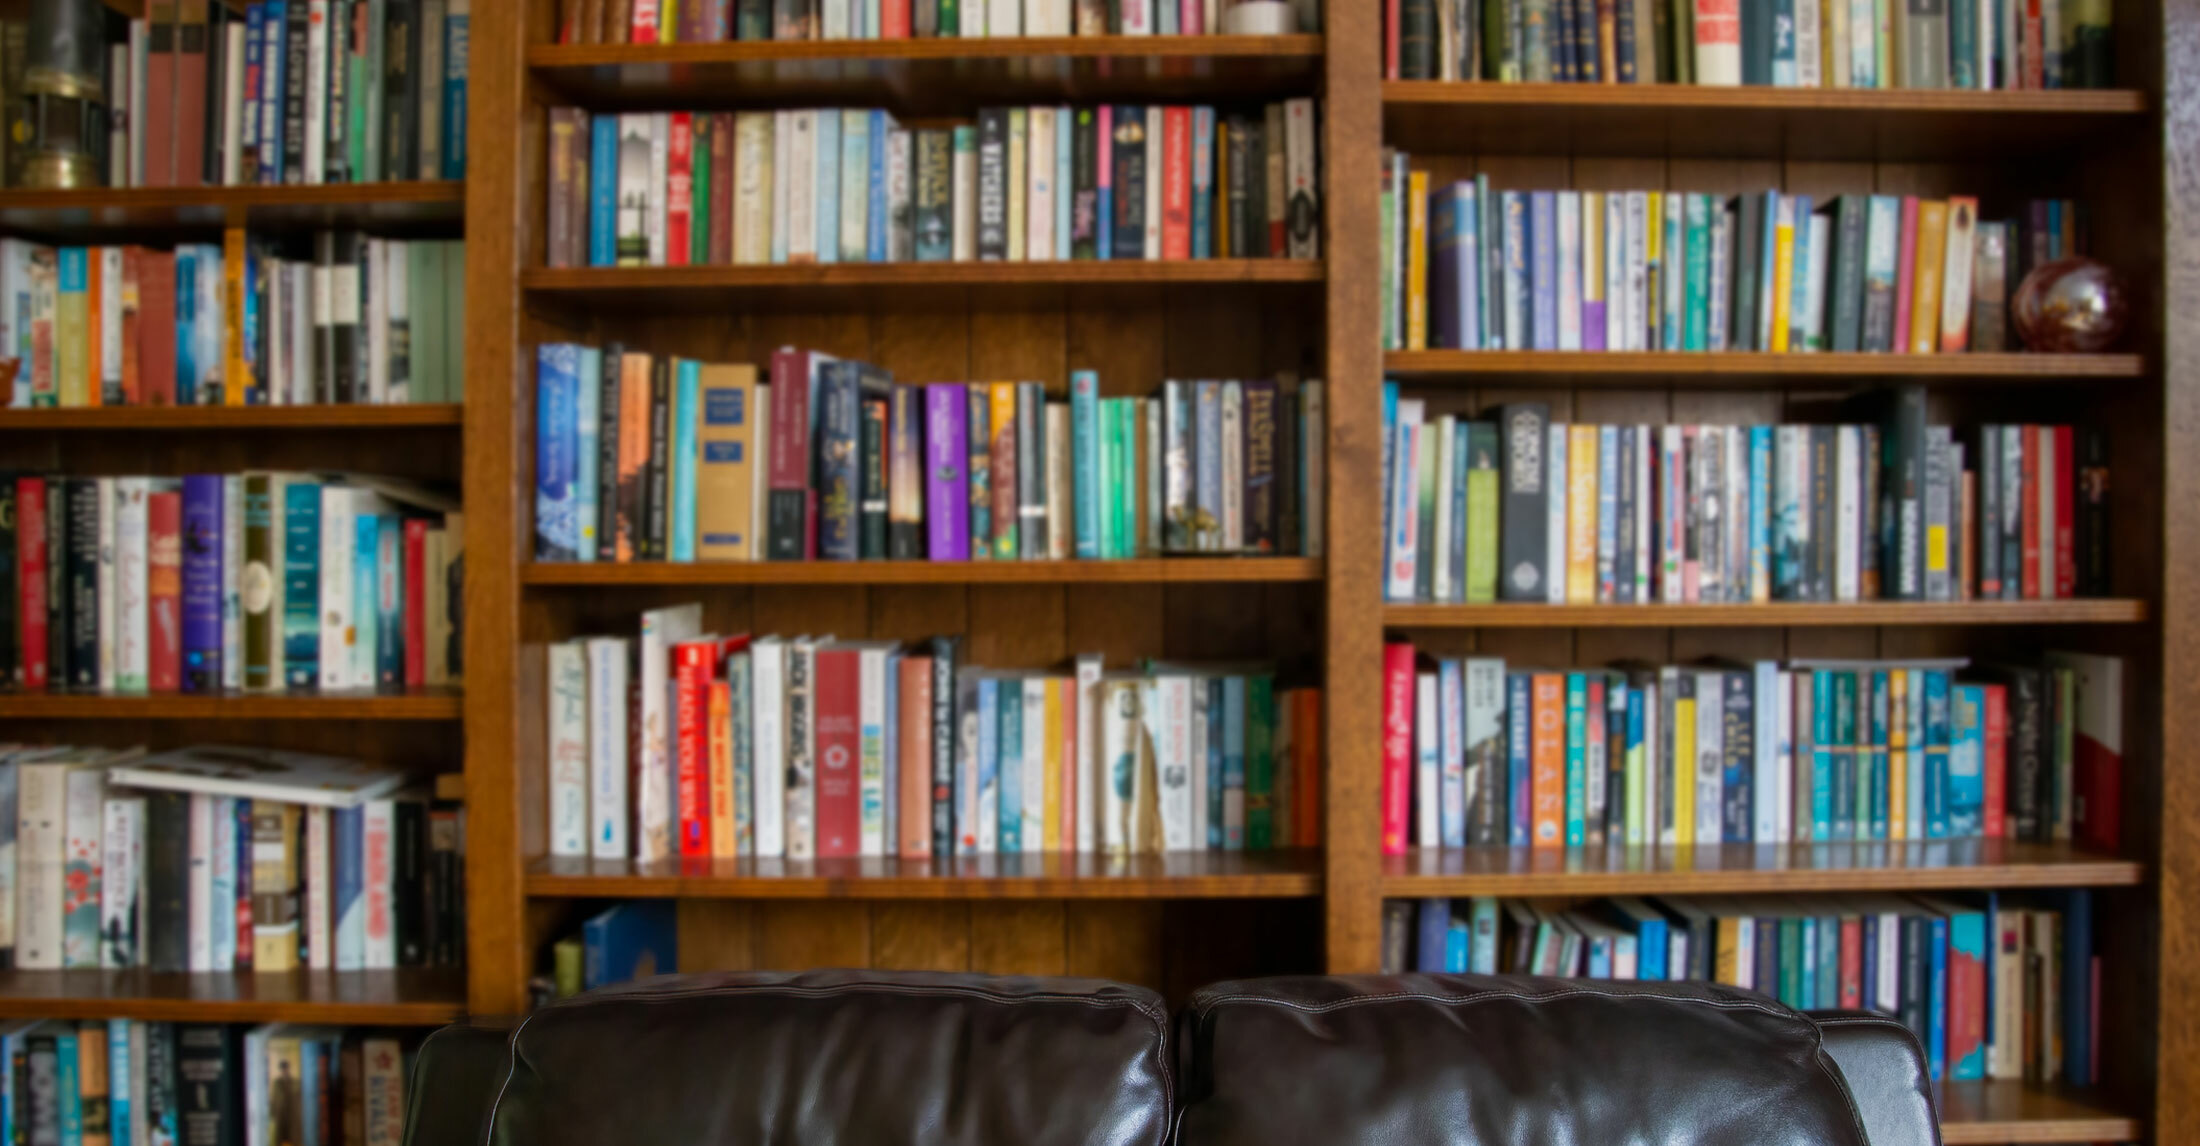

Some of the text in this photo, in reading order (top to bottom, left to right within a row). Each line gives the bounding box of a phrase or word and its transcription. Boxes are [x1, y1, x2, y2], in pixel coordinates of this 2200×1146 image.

[934, 658, 950, 703] JOHN
[678, 665, 699, 820] HEADS YOU WIN
[790, 694, 807, 759] HIGGINS
[1723, 712, 1737, 767] CHILD
[1737, 722, 1751, 757] LEE
